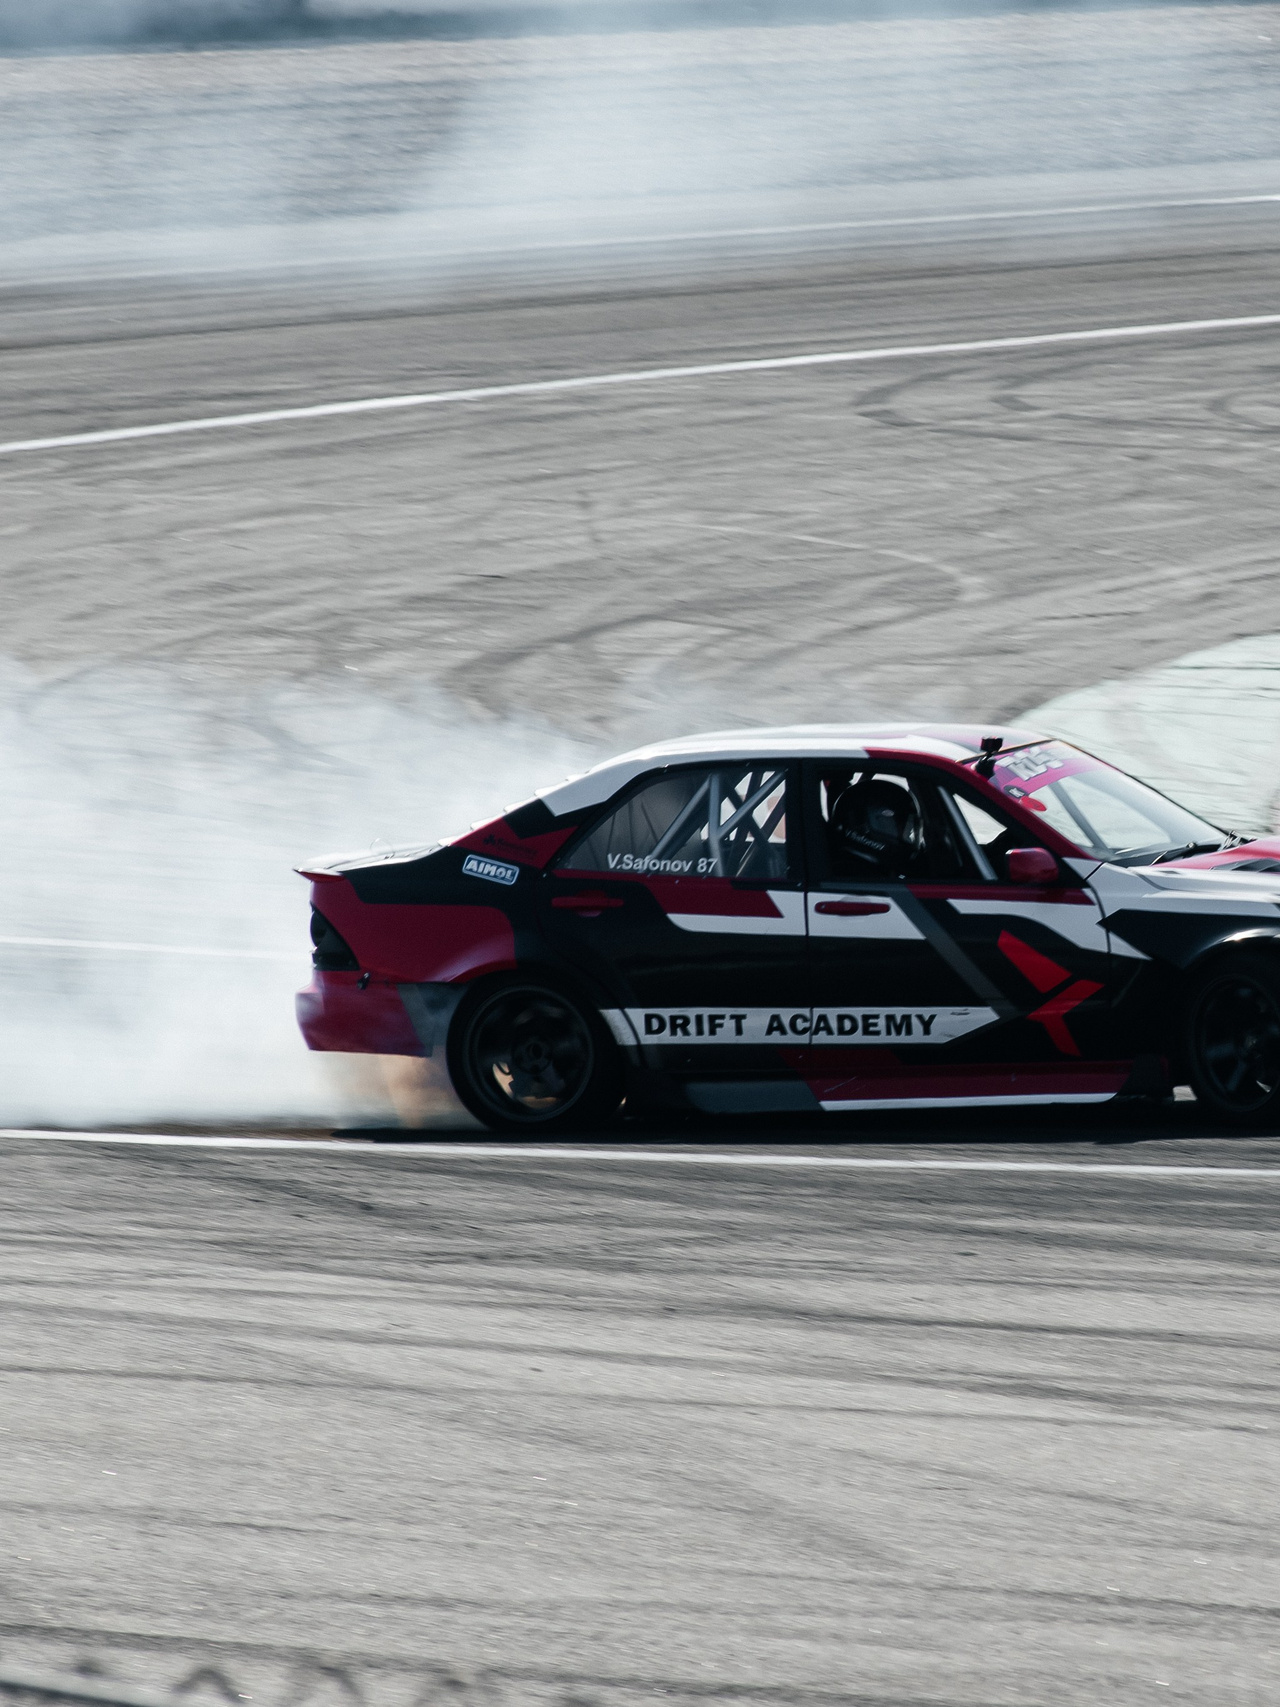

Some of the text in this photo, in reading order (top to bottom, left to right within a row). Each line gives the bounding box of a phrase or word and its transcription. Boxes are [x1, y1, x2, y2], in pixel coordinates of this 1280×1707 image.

[465, 859, 515, 881] AIMOL
[607, 853, 718, 873] V.Safonov 87
[644, 1013, 938, 1037] DRIFT ACADEMY
